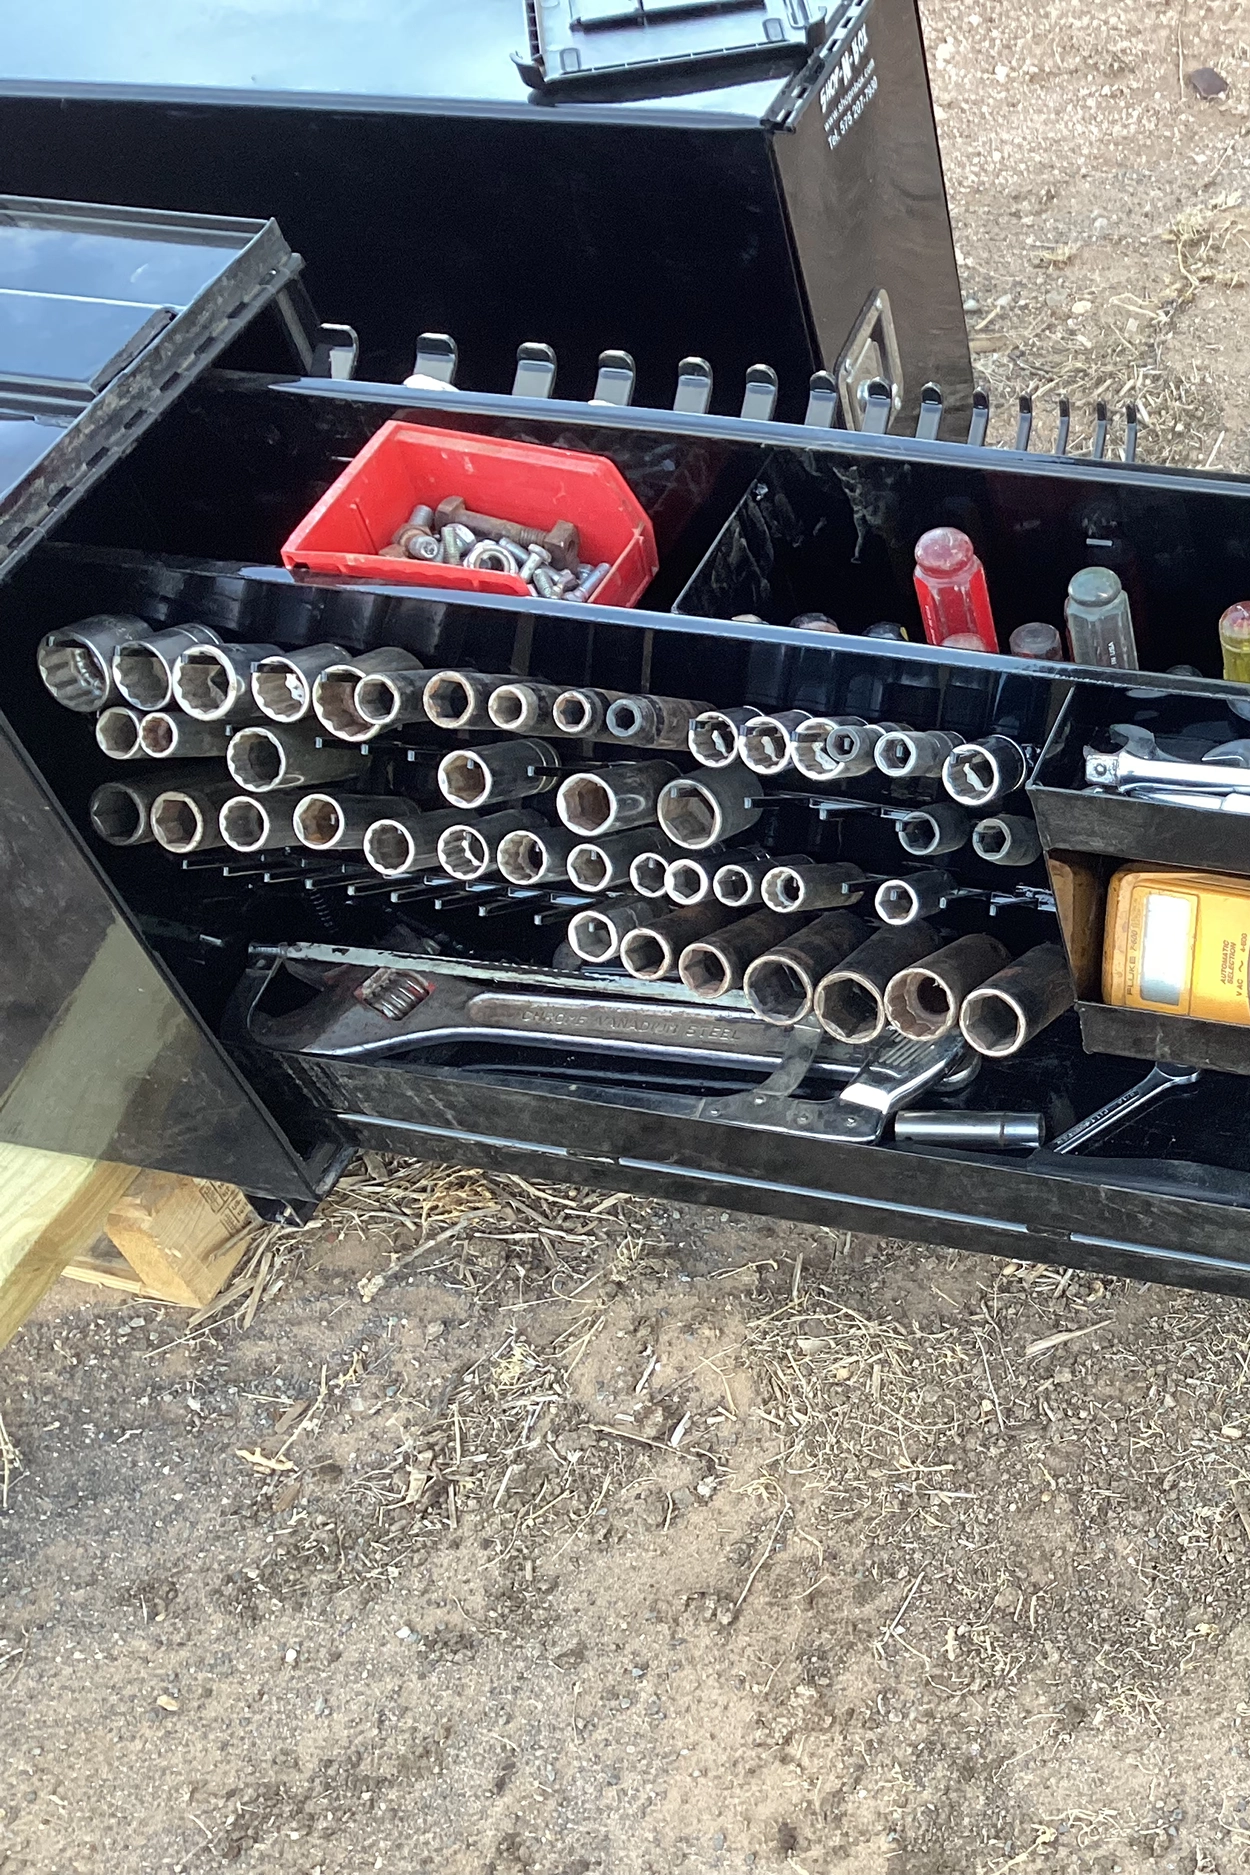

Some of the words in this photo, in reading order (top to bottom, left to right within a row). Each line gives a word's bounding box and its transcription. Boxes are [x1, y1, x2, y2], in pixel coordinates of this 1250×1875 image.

[1126, 956, 1137, 996] FLUKE
[1220, 939, 1230, 985] AUTOMATIC
[1227, 941, 1237, 985] SELECTION
[521, 1010, 588, 1026] CHROME
[596, 1015, 678, 1036] VANADIUM
[685, 1024, 741, 1041] STEEL
